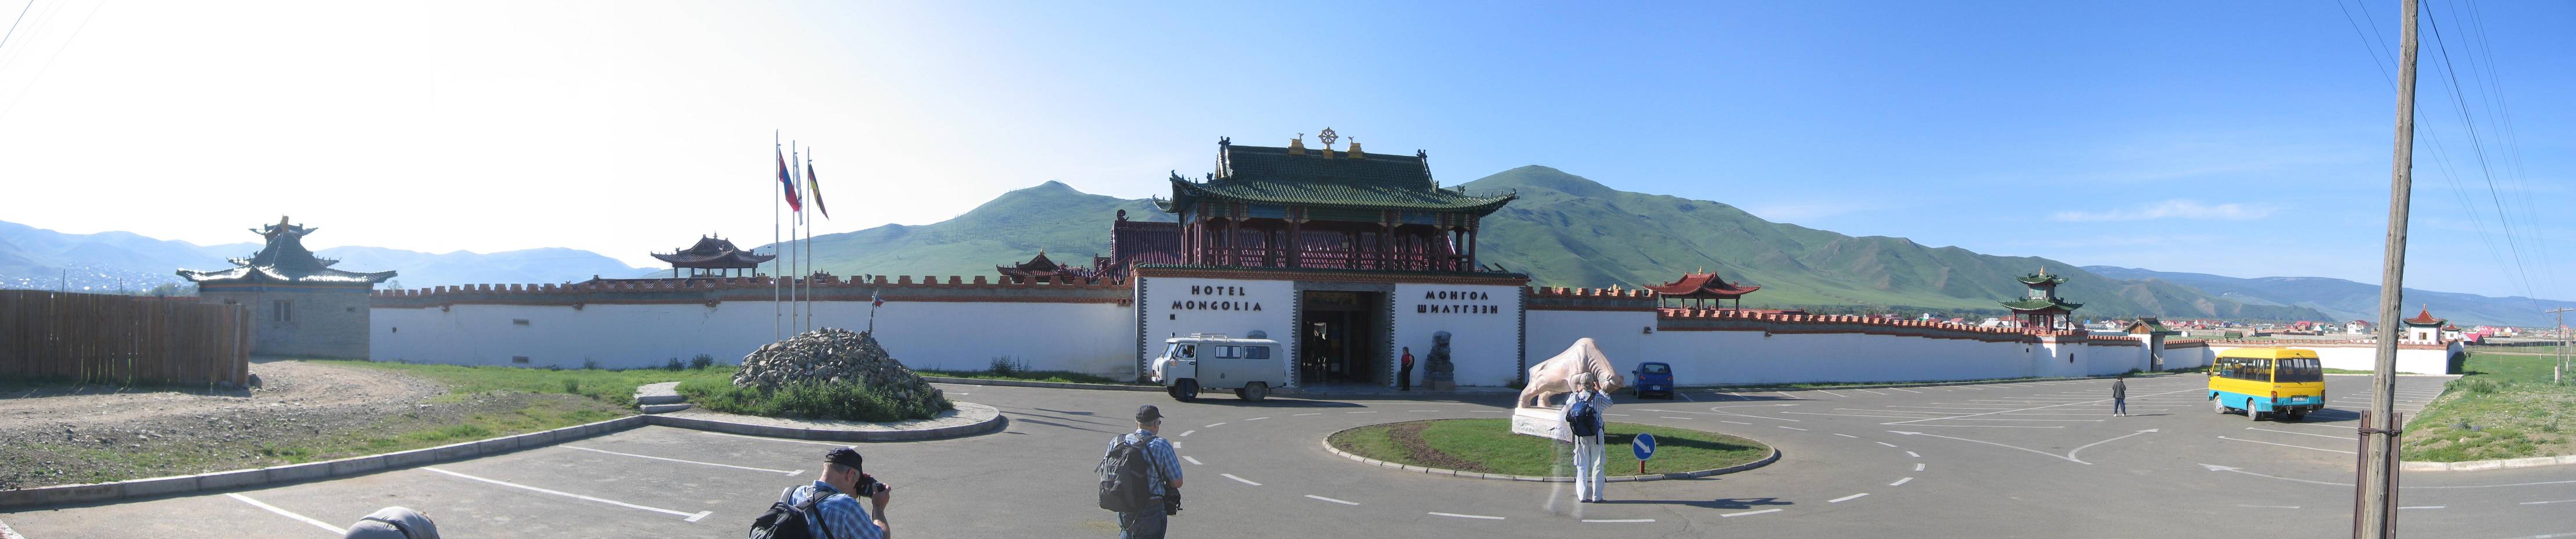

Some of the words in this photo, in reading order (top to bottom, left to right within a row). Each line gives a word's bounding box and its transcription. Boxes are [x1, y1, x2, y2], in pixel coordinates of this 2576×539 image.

[1192, 285, 1245, 296] HOTEL
[1425, 290, 1489, 300] МОНГОЛ
[1172, 300, 1262, 311] MONGOLIA
